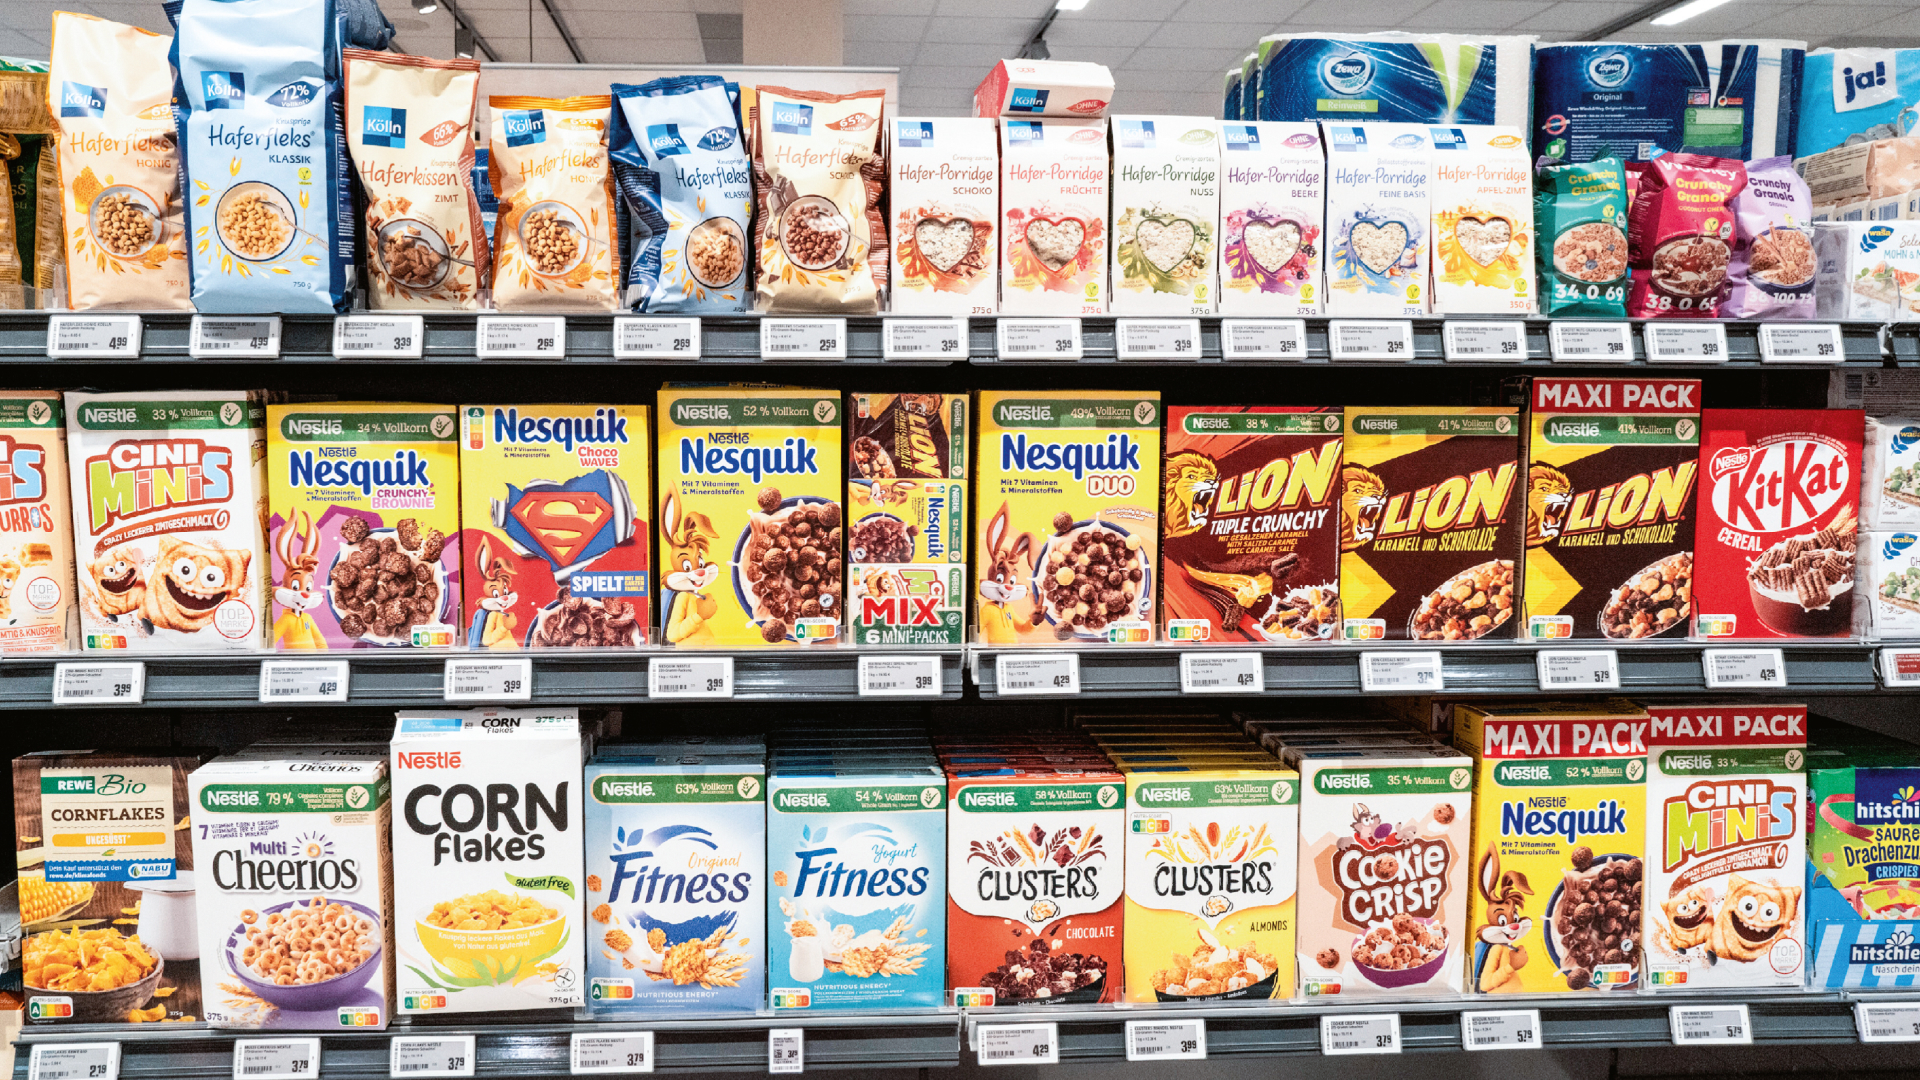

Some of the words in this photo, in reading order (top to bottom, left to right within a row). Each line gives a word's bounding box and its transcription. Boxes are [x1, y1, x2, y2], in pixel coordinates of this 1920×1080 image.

[1335, 63, 1362, 75] Zewa
[207, 83, 241, 98] Kölln
[1844, 62, 1886, 103] ja!
[64, 91, 102, 108] Kölln
[280, 84, 310, 101] 72%
[1014, 96, 1043, 106] Kölln
[1593, 93, 1622, 101] Original
[367, 117, 402, 135] Kölln
[508, 118, 542, 133] Kölln
[776, 113, 808, 126] Kölln
[208, 124, 311, 150] Haferfleks
[901, 128, 930, 138] Kölln
[70, 133, 170, 154] Haferfleks
[137, 159, 171, 168] HONIG
[269, 155, 311, 164] KLASSIK
[520, 150, 601, 181] Haferfleks
[361, 160, 458, 186] Haferkissen
[675, 164, 748, 189] Haferfleks
[899, 163, 993, 182] Hafer-Porridge
[1010, 163, 1103, 182] Hafer-Porridge
[1122, 165, 1215, 183] Hafer-Porridge
[1228, 167, 1319, 186] Hafer-Porridge
[1335, 168, 1426, 187] Hafer-Porridge
[1438, 166, 1527, 184] Hafer-Porridge
[953, 187, 992, 195] SCHOKO
[1061, 185, 1103, 195] FRÜCHTE
[1191, 188, 1214, 196] NUSS
[1477, 186, 1527, 194] APFEL-ZIMT
[1676, 178, 1732, 191] Crunchy
[1749, 178, 1791, 191] Crunchy
[435, 195, 458, 203] ZIMT
[1754, 189, 1794, 202] Granola
[1539, 384, 1611, 407] MAXI
[1624, 385, 1694, 407] PACK
[153, 409, 166, 419] 33
[168, 409, 178, 418] %
[181, 409, 213, 417] Vollkorn
[1071, 408, 1094, 417] 49%
[1096, 407, 1131, 415] Vollkorn
[495, 409, 627, 451] Nesquik
[112, 443, 198, 467] CINI
[578, 447, 617, 457] Choco
[682, 438, 817, 482] Nesquik
[1002, 434, 1139, 480] Nesquik
[581, 458, 618, 466] WAVES
[290, 450, 428, 495] Nesquik
[377, 489, 428, 499] CRUNCHY
[1088, 477, 1134, 495] DUO
[1728, 443, 1845, 530] KitKat
[372, 498, 434, 508] BROWNIE
[1210, 516, 1249, 535] TRIPLE
[1252, 510, 1328, 533] CRUNCHY
[103, 532, 122, 546] CRAZY
[124, 525, 153, 541] LECKERER
[1374, 538, 1420, 551] KARAMELL
[1439, 527, 1498, 550] SCHOKOLADE
[1718, 528, 1762, 552] CEREAL
[573, 576, 623, 592] SPIELT
[864, 598, 941, 626] MIX
[866, 630, 879, 643] 6
[883, 630, 949, 643] MINI-PACKS
[1650, 717, 1722, 737] MAXI
[1734, 716, 1803, 736] PACK
[1484, 725, 1567, 755] MAXI
[1572, 723, 1648, 754] PACK
[59, 781, 93, 791] REWE
[98, 774, 146, 795] Bio
[1688, 785, 1767, 808] CINI
[51, 808, 164, 822] CORNFLAKES
[404, 781, 569, 835] CORN
[1857, 801, 1920, 819] hitschi
[1502, 801, 1626, 842] Nesquik
[250, 841, 286, 855] Multi
[872, 843, 918, 865] Yogurt
[142, 864, 169, 872] NABU
[212, 849, 358, 891] Cheerios
[688, 852, 741, 874] Original
[1876, 865, 1918, 878] CRISPIES
[608, 851, 751, 904] Fitness
[793, 847, 929, 898] Fitness
[1154, 862, 1274, 896] CLUSTERS
[515, 877, 546, 888] gluten
[548, 877, 569, 891] free
[978, 867, 1099, 900] CLUSTERS
[1067, 926, 1115, 939] CHOCOLATE
[1250, 920, 1288, 932] ALMONDS
[1875, 965, 1902, 974] Nasch
